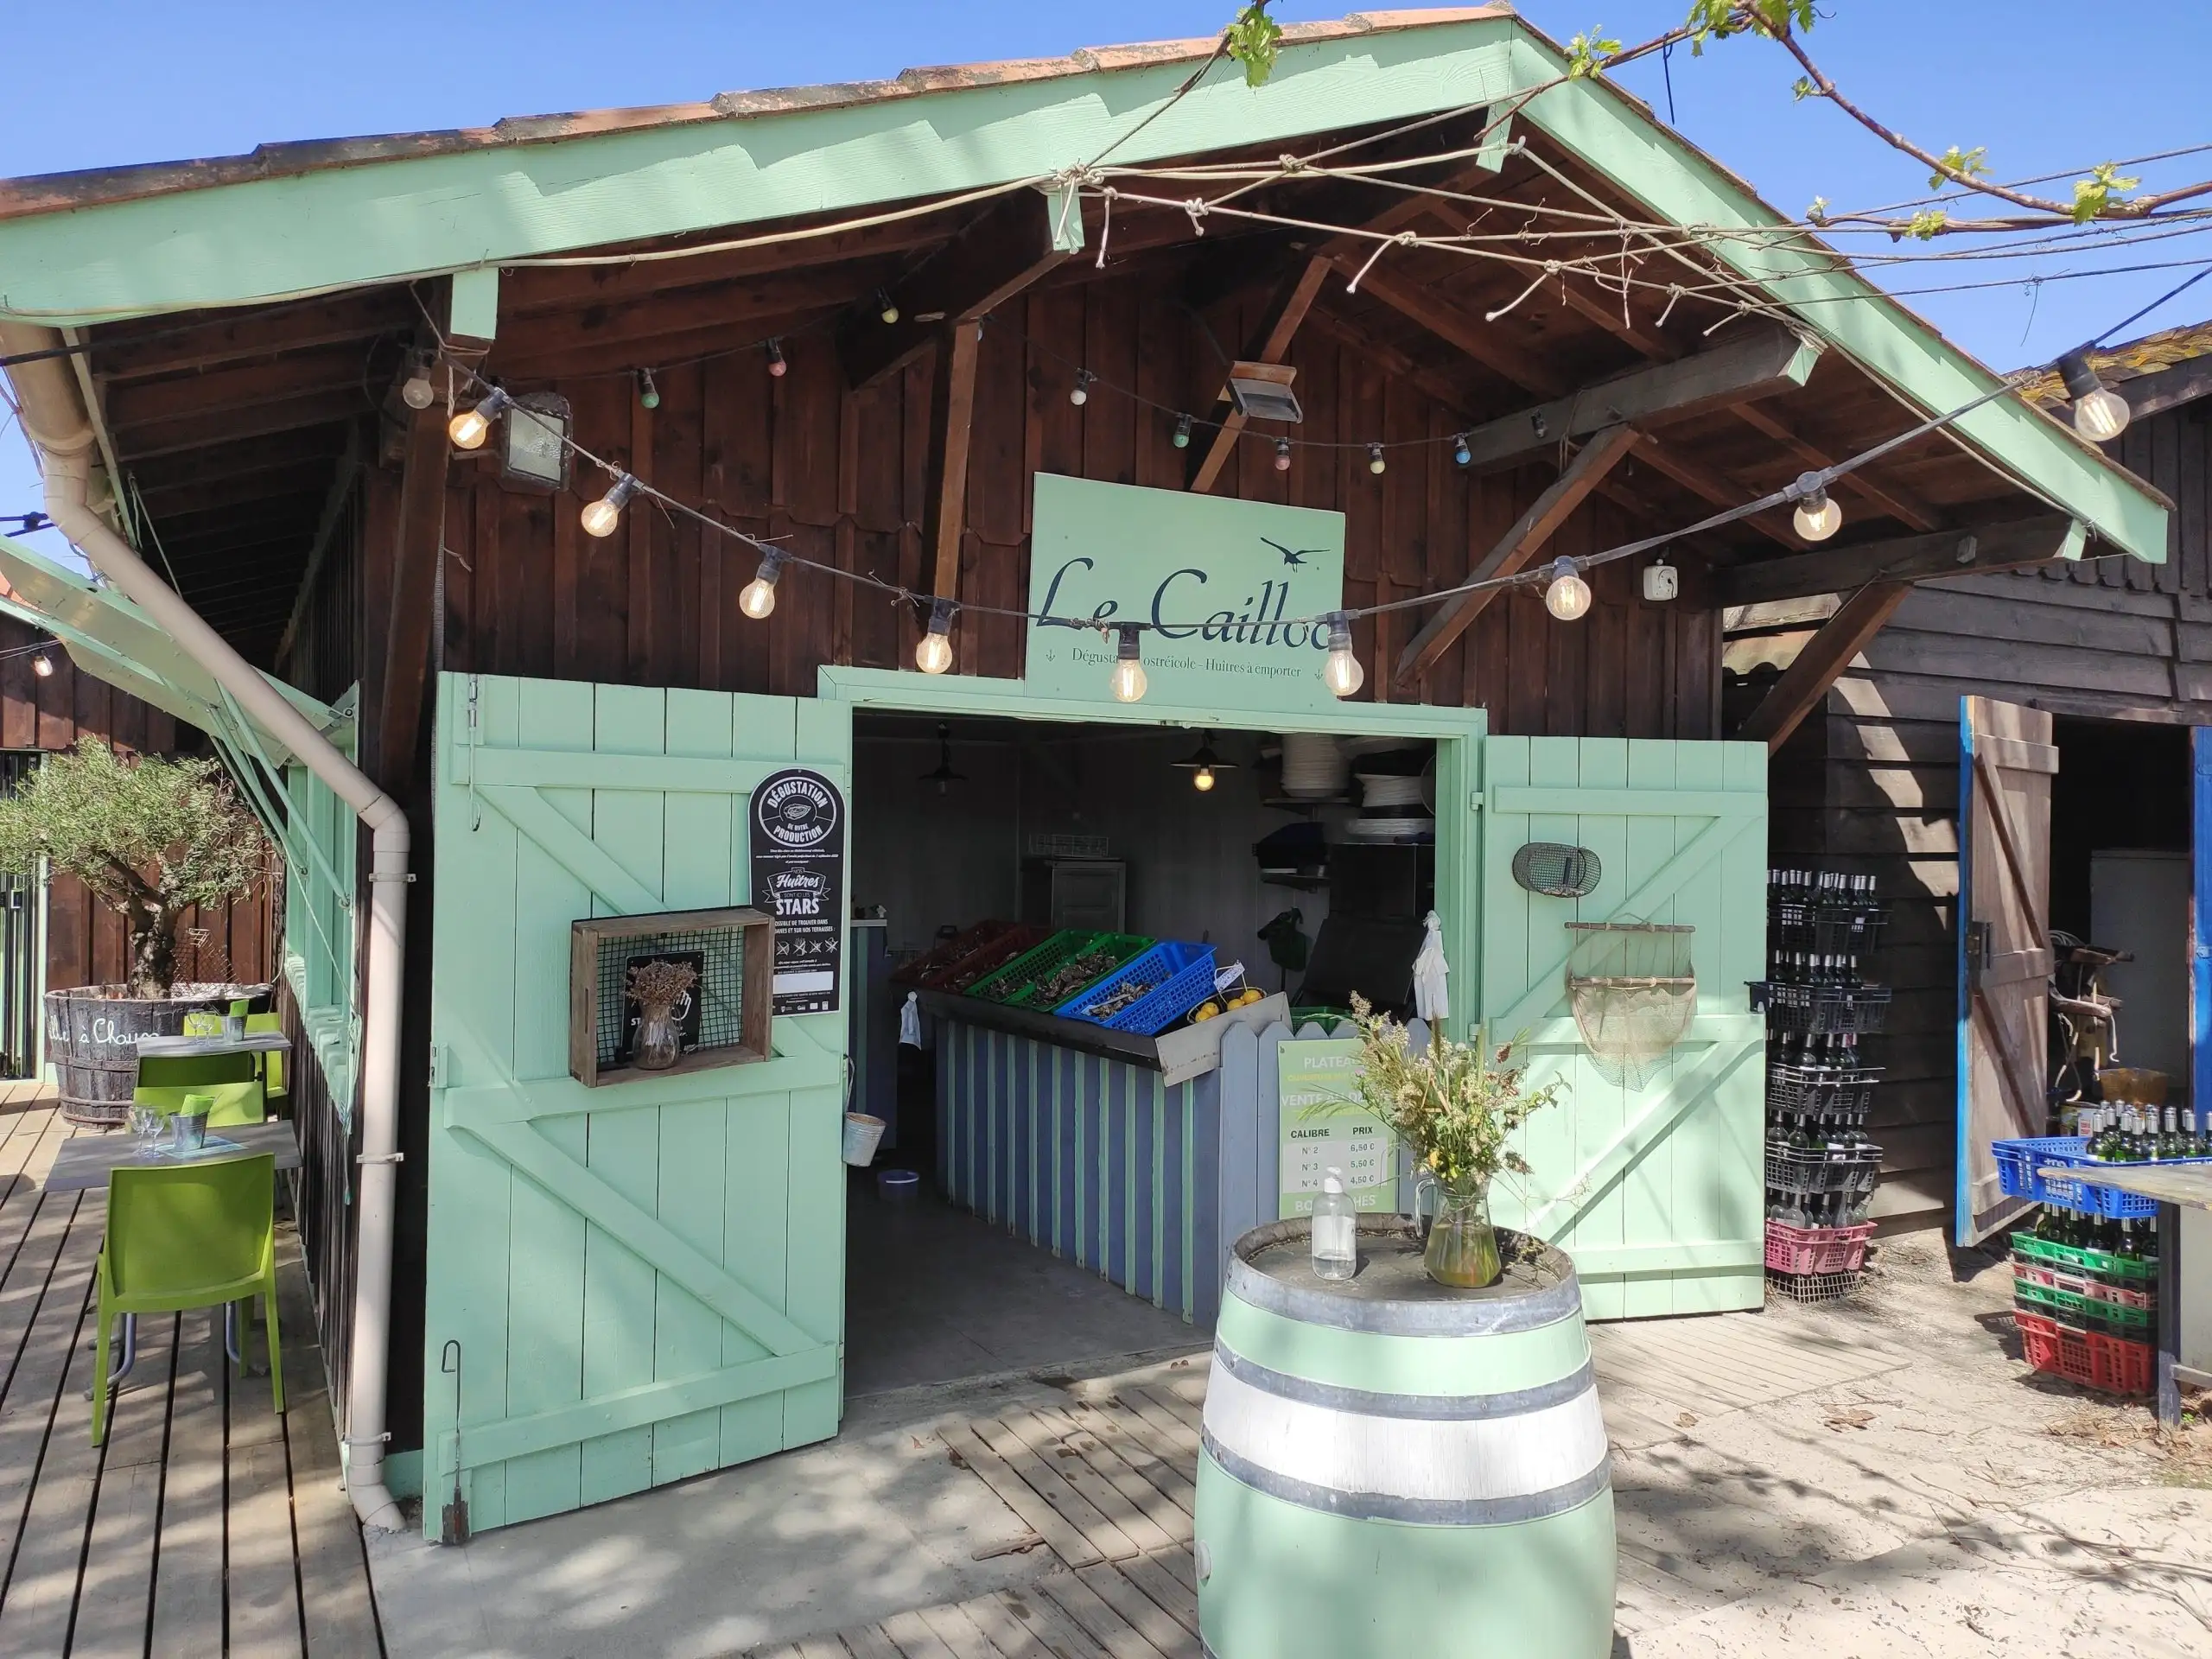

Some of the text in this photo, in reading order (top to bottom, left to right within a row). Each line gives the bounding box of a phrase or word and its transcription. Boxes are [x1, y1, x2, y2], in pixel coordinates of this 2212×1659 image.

[1036, 557, 1118, 631] Le
[1072, 647, 1119, 666] Dégusta
[1143, 656, 1197, 671] ostréicole
[1205, 658, 1245, 674] Huîtres
[1247, 663, 1253, 674] à
[1255, 664, 1301, 677] emporter
[766, 781, 829, 809] DÉGUSTATION
[772, 824, 823, 842] PRODUCTION
[776, 874, 819, 888] Huîtres
[776, 898, 820, 916] STARS
[79, 1025, 90, 1043] à
[1304, 1056, 1359, 1069] PLATEA
[1290, 1126, 1373, 1139] CALIBRE PRIX
[1350, 1143, 1368, 1152] 6,50
[1350, 1160, 1368, 1168] 5,50
[1350, 1176, 1368, 1185] 4,50
